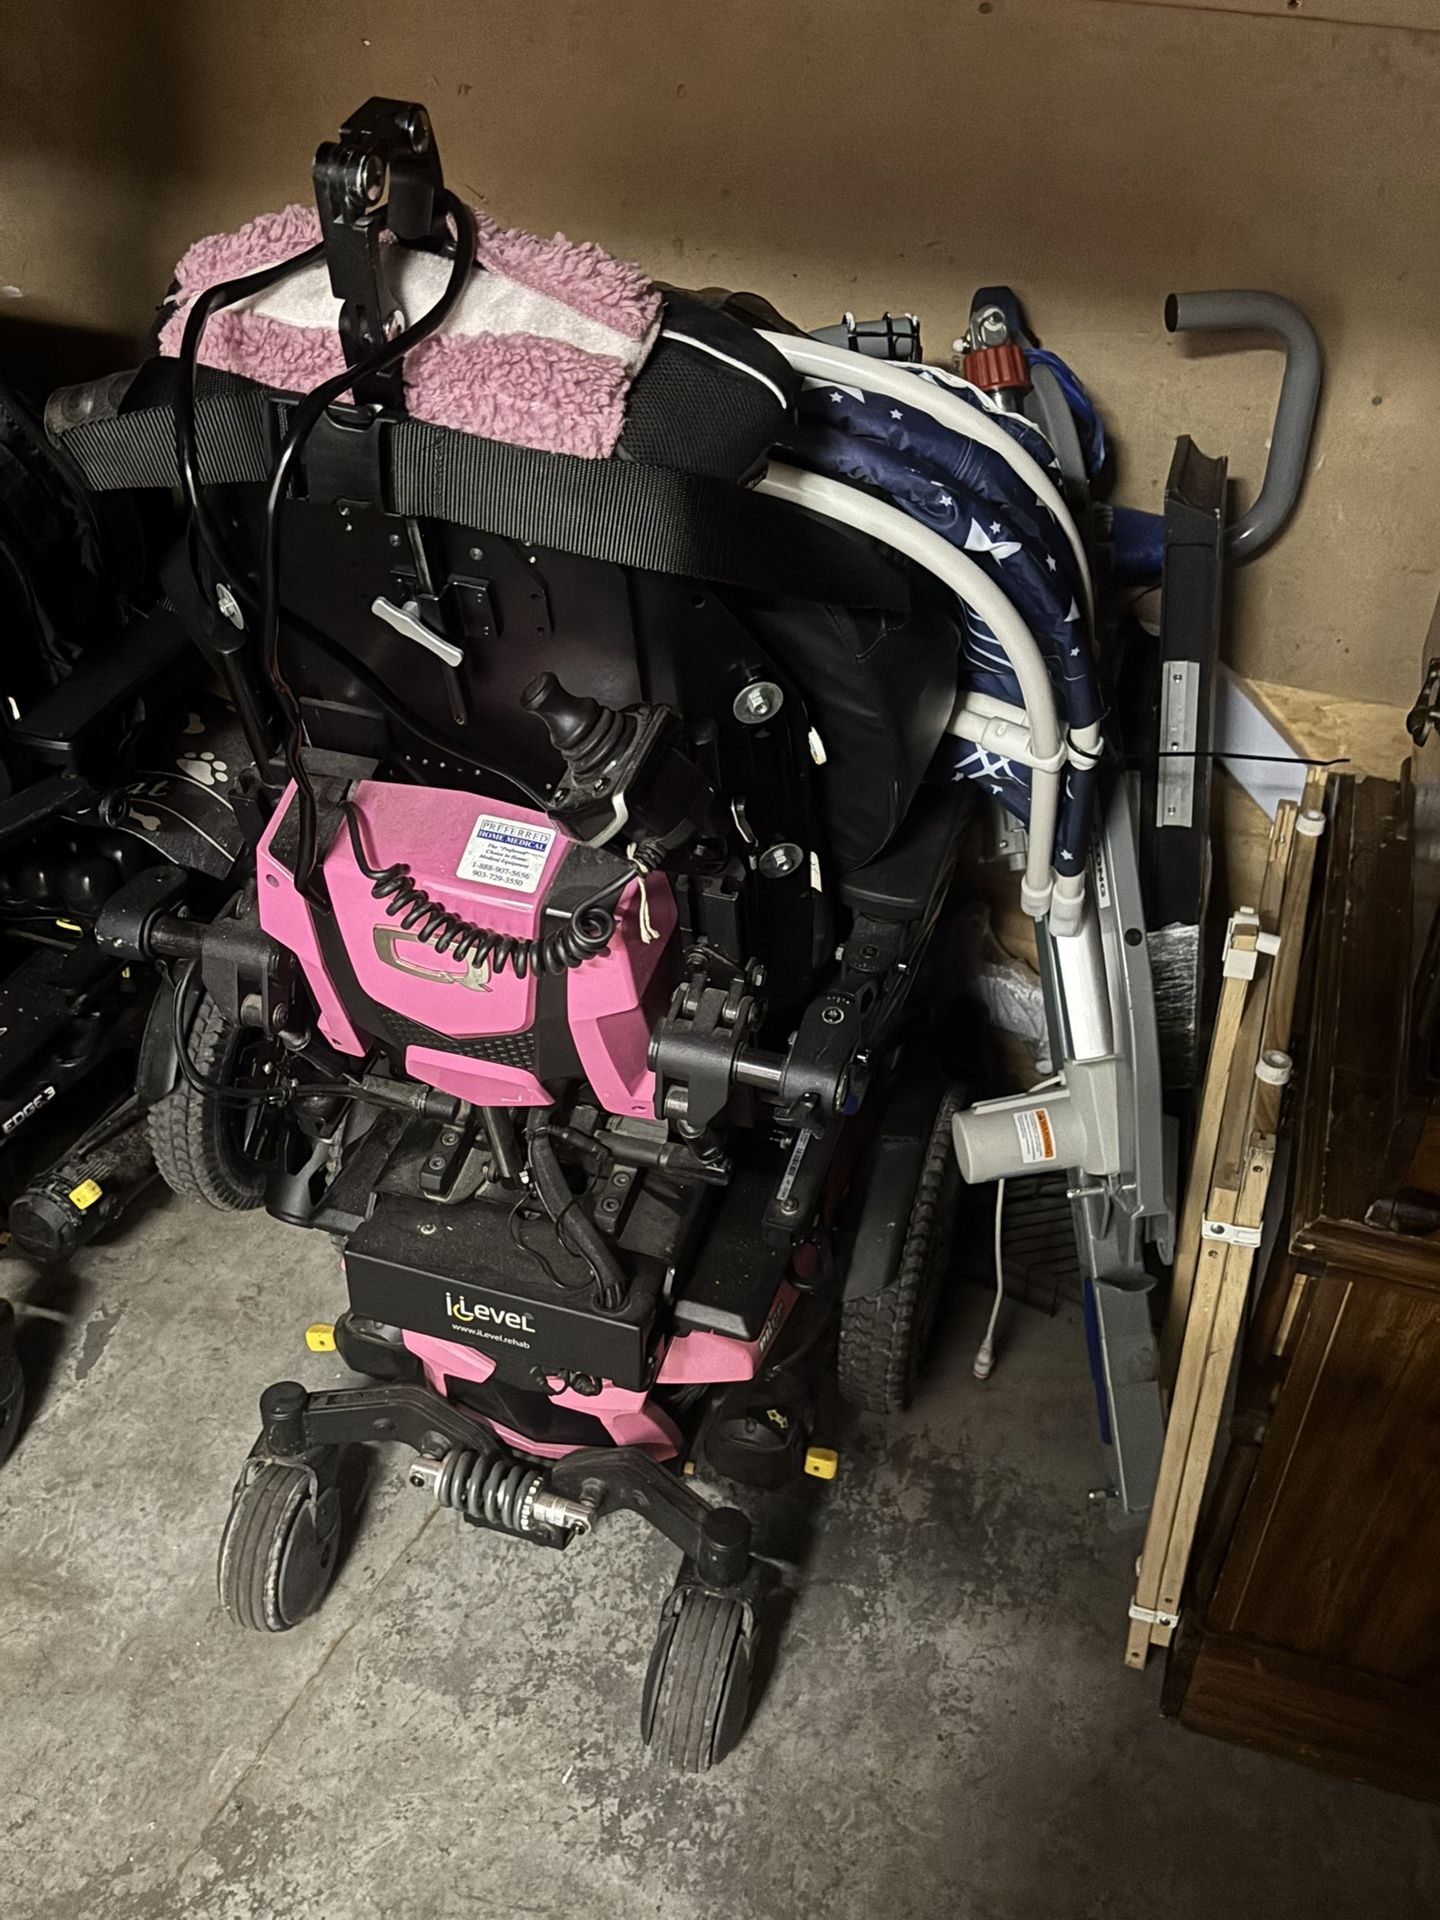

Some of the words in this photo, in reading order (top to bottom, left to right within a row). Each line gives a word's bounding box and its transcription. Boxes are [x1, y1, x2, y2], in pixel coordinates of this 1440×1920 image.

[478, 831, 505, 841] HOME
[506, 835, 545, 850] MEDICAL
[482, 822, 548, 842] PREFERRED
[479, 854, 500, 863] Medical
[501, 858, 529, 868] Equipment
[486, 849, 504, 857] Choice
[472, 861, 530, 880] 1-888-907-5656
[472, 870, 524, 886] 903-729-3550
[451, 1323, 530, 1349] www.iLevel.rehab
